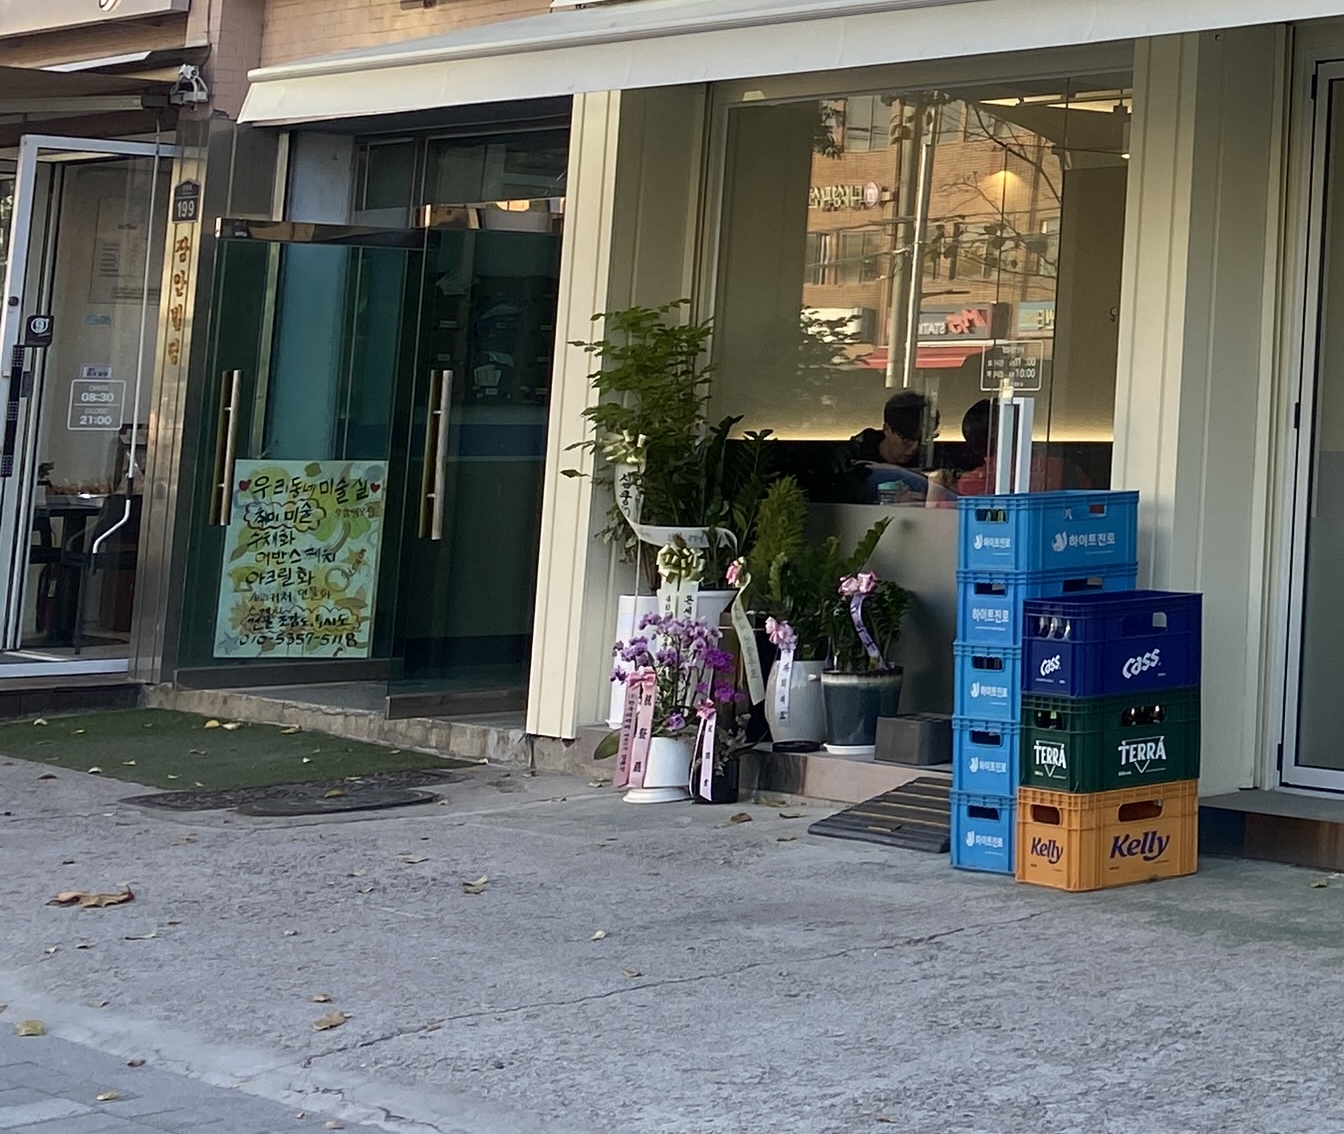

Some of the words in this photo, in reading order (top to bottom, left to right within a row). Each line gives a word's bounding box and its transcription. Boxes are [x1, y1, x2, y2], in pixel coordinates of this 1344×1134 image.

[177, 200, 195, 218] 199
[81, 392, 114, 402] 08:30
[79, 415, 112, 425] 21:00
[1068, 532, 1116, 547] 하이트진로
[972, 607, 1010, 624] 하이트진로
[1040, 654, 1061, 677] Cass
[1122, 648, 1161, 679] Cass
[1034, 742, 1067, 769] TERRA
[1118, 739, 1167, 765] TERRA
[1030, 836, 1064, 865] Kelly
[1109, 830, 1171, 862] Kelly
